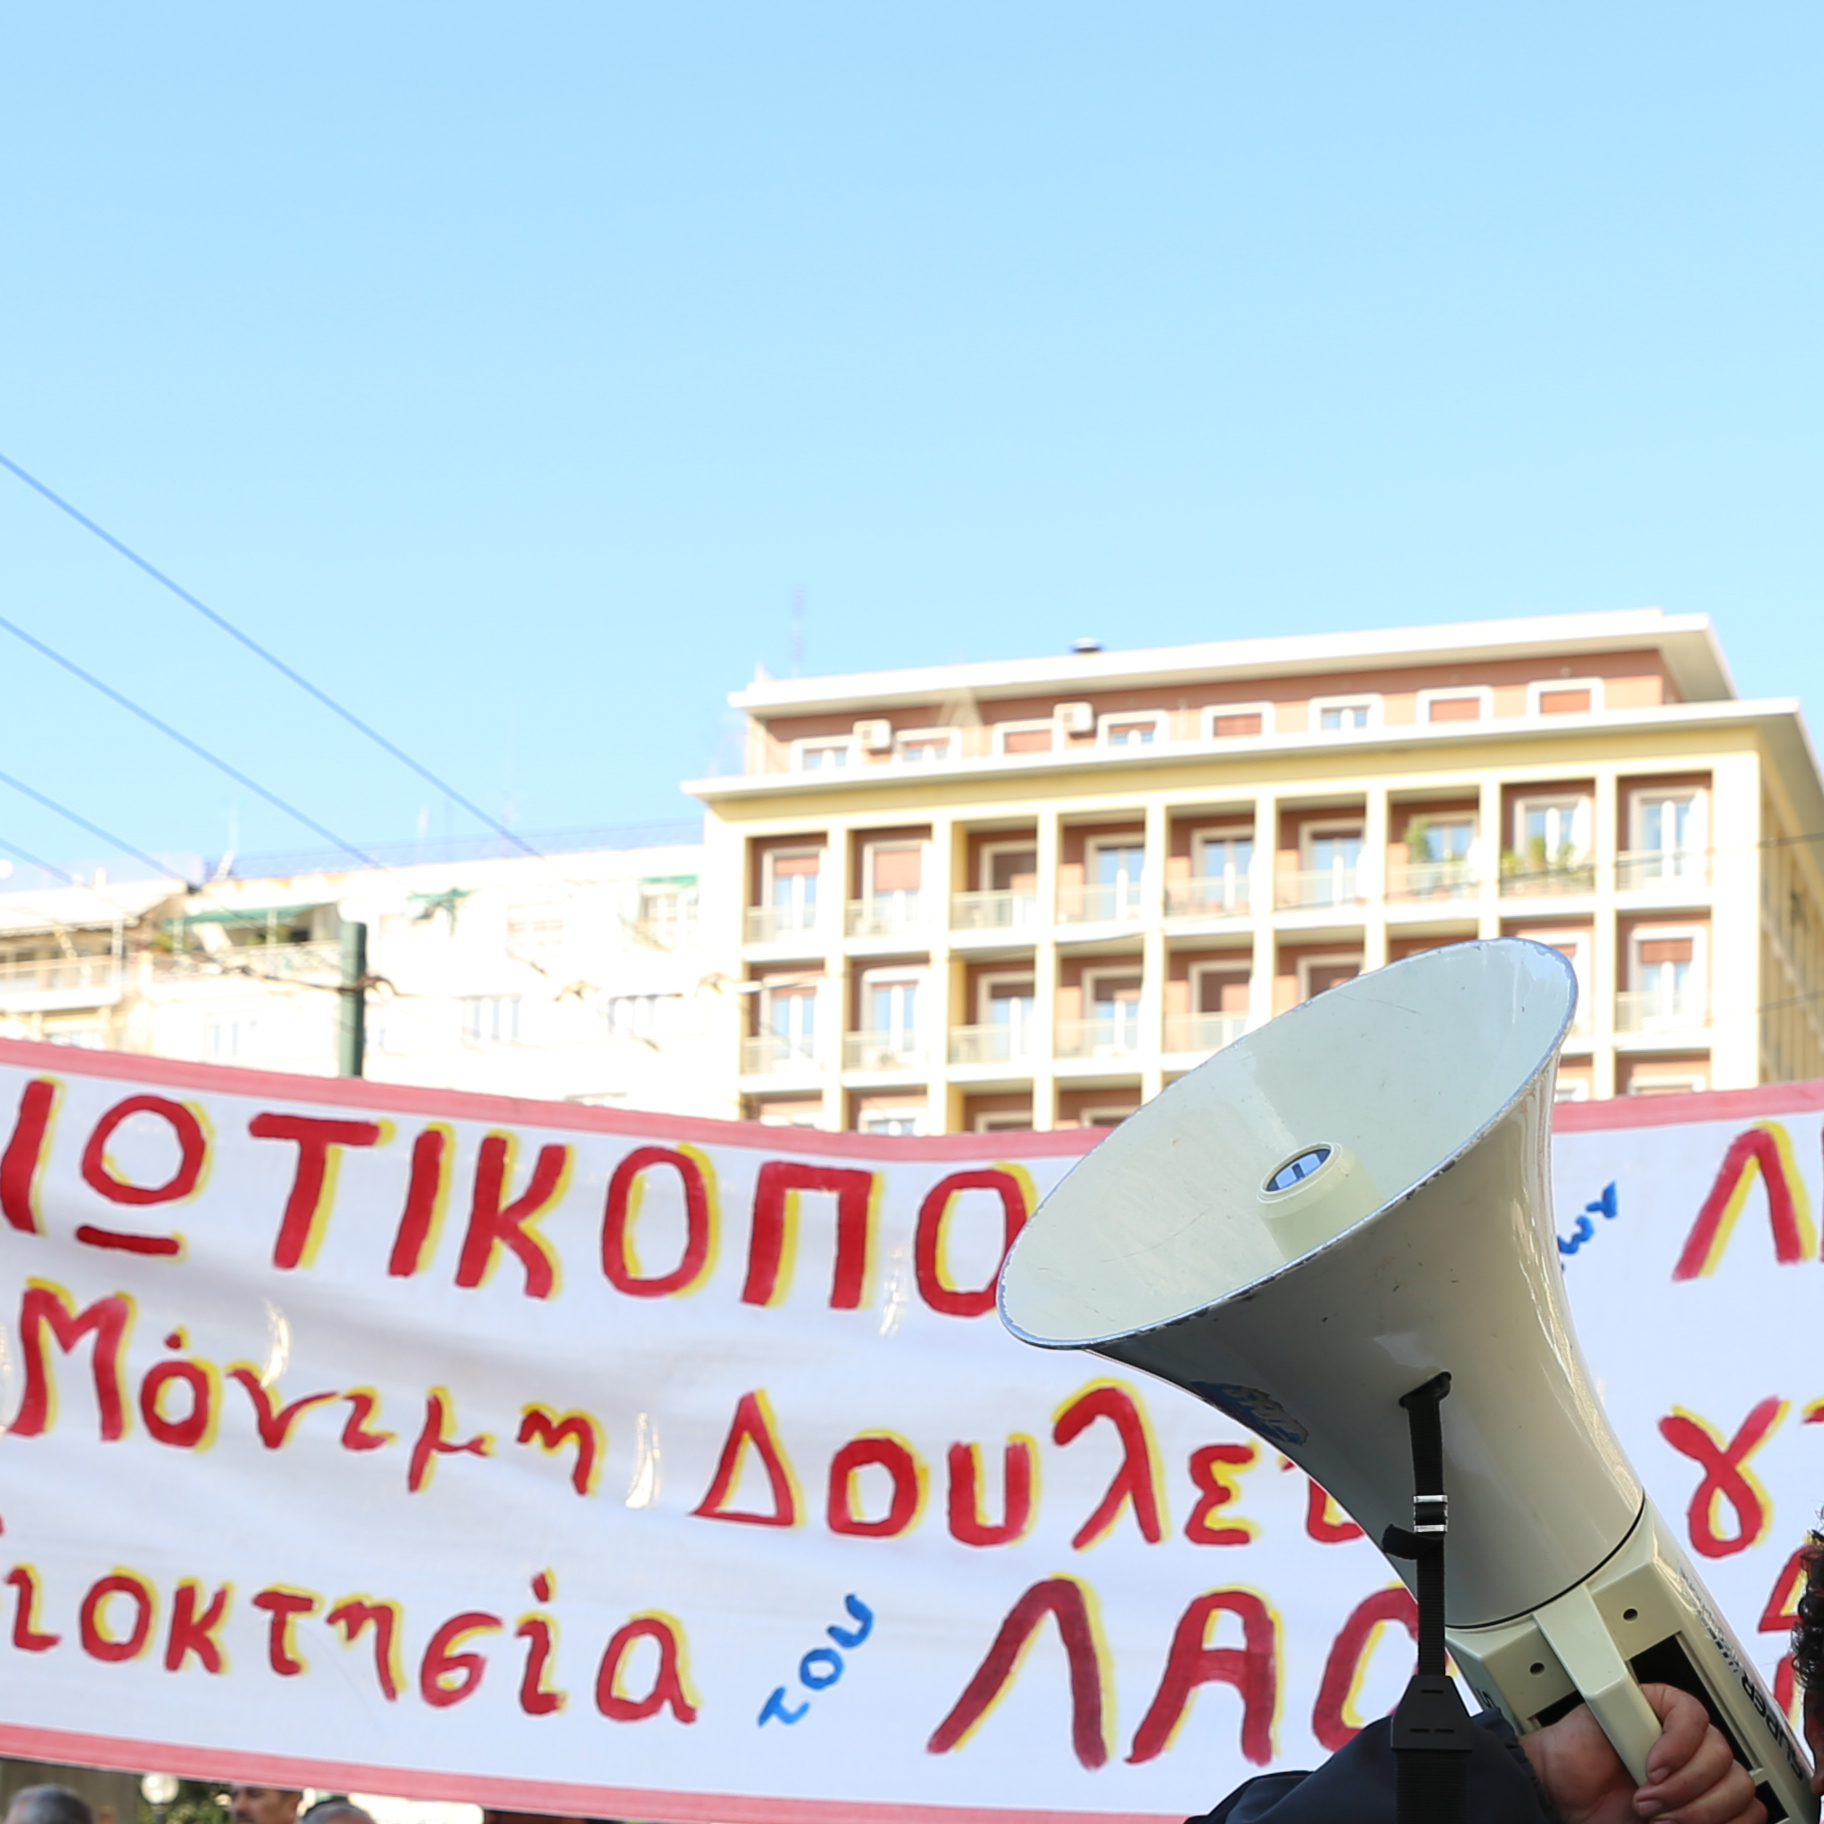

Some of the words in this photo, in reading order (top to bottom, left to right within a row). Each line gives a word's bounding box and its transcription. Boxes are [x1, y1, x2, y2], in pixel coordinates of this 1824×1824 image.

[8, 1277, 608, 1496] Μόνιμη
[757, 1593, 875, 1728] του
[925, 1572, 1451, 1770] ΛΑΟ
